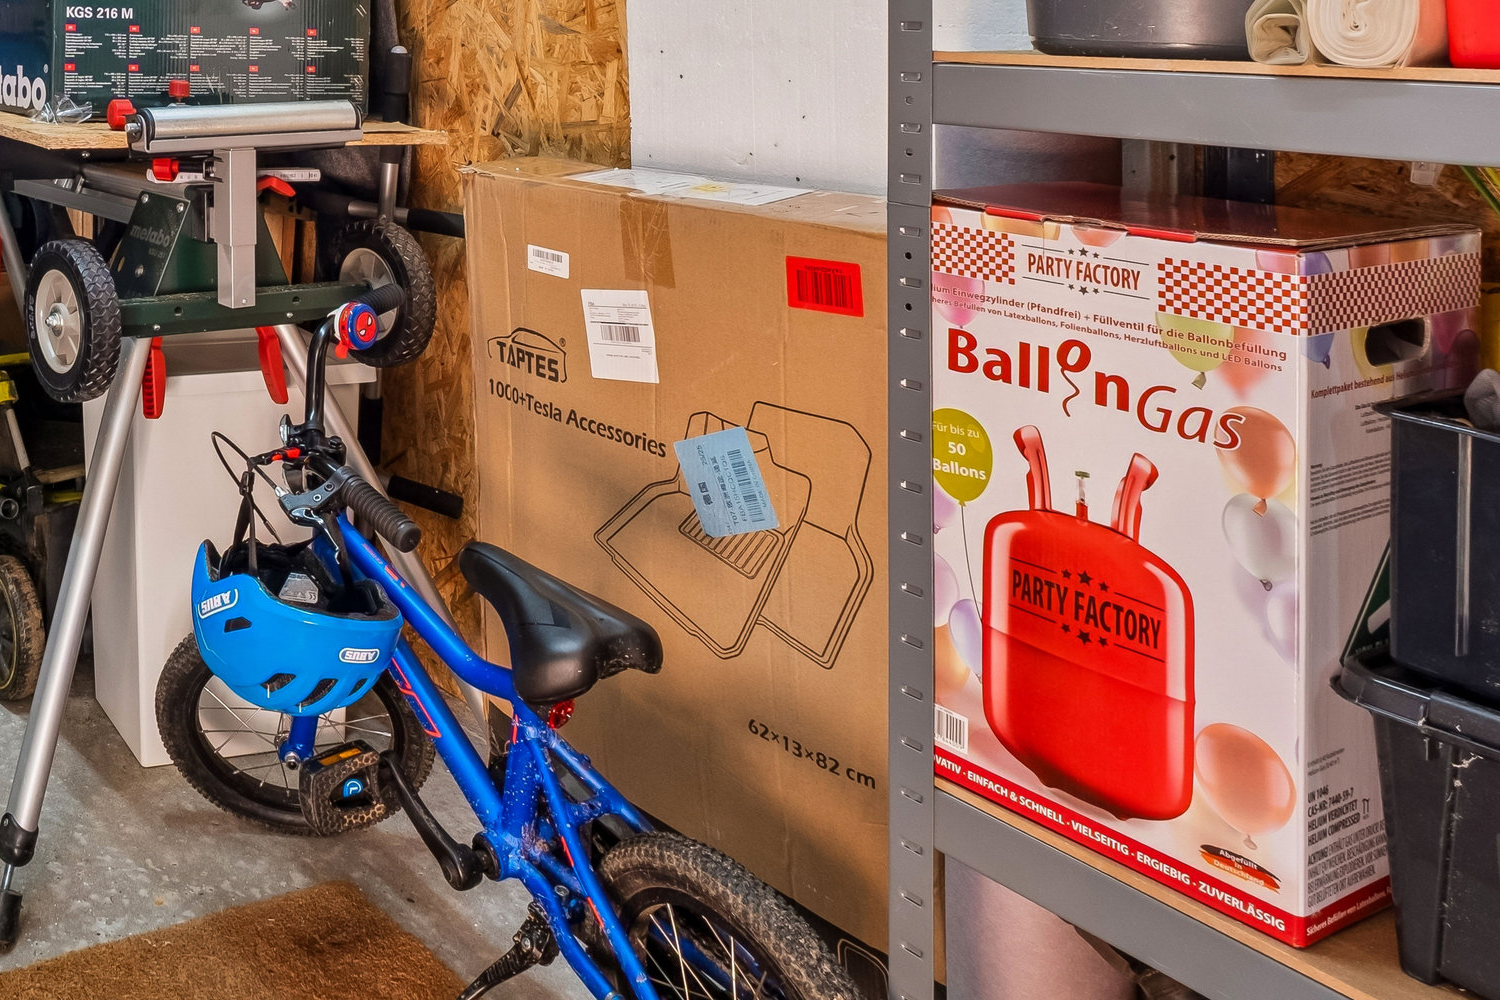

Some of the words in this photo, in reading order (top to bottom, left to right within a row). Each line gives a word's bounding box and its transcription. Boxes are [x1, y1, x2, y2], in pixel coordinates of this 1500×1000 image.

[66, 6, 93, 19] KGS
[96, 7, 118, 19] 216
[121, 7, 134, 19] M
[130, 224, 171, 247] metabo
[1027, 253, 1072, 280] PARTY
[1076, 260, 1141, 291] FACTORY
[953, 288, 1025, 309] Einwegzylinder
[1027, 302, 1081, 321] (Pfandfrei)
[1093, 314, 1144, 332] Füllventil
[1147, 324, 1163, 335] für
[1166, 328, 1185, 340] die
[1187, 332, 1287, 361] Ballonbefüllung
[1003, 310, 1058, 328] Latexballons,
[1060, 322, 1121, 340] Folienballons,
[1124, 333, 1198, 355] Herzluftballons
[1200, 349, 1219, 359] und
[1222, 353, 1241, 364] LED
[1244, 357, 1283, 372] Ballons
[496, 341, 559, 383] TAPTES
[565, 409, 667, 458] Accessories
[950, 424, 963, 436] bis
[966, 428, 980, 439] zu
[948, 441, 966, 456] 50
[932, 458, 986, 480] Ballons
[201, 590, 231, 614] ABUS
[1012, 569, 1069, 616] PARTY
[1074, 590, 1161, 649] FACTORY
[344, 651, 376, 661] ABUS
[846, 767, 876, 790] cm
[1308, 814, 1328, 832] HELIUM
[1308, 829, 1328, 847] HELIUM
[967, 770, 1008, 798] EINFACH
[1010, 791, 1018, 802] &
[1019, 796, 1064, 825] SCHNELL
[1071, 820, 1129, 855] VIELSEITIG
[1136, 851, 1190, 886] ERGIEBIG
[1199, 881, 1286, 932] ZUVERLÄSSIG
[1219, 850, 1258, 870] Abgefüllt
[1213, 859, 1265, 886] Deutschland
